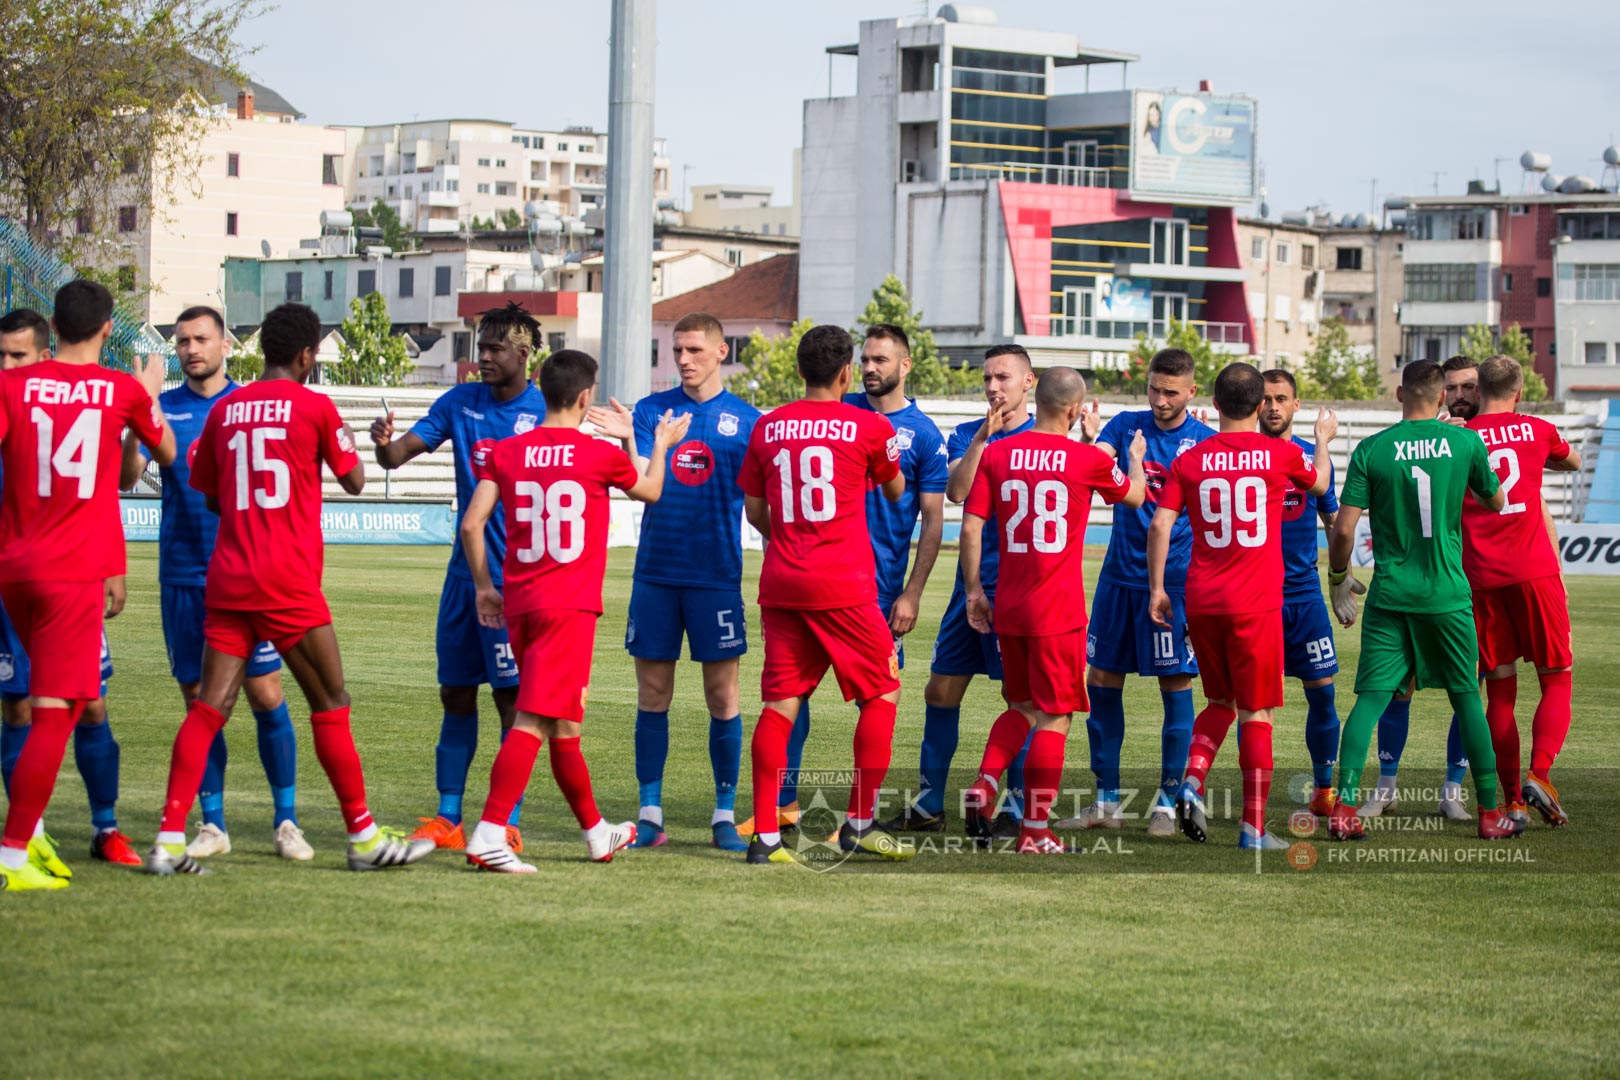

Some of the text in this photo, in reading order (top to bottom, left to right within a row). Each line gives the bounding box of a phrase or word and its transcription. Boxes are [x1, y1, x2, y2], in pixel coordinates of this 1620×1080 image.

[24, 378, 114, 407] FERATI
[222, 400, 292, 427] JAITEH
[765, 419, 857, 443] CARDOSO
[31, 406, 102, 499] 14
[525, 444, 575, 468] KOTE
[1010, 449, 1067, 472] DUKA
[1202, 450, 1270, 472] KALARI
[1394, 438, 1452, 461] XHIKA
[227, 427, 290, 511] 15
[1488, 448, 1526, 515] 2
[772, 445, 837, 523] 18
[1199, 476, 1267, 548] 99
[1411, 465, 1432, 538] 1
[363, 513, 421, 530] DURRES
[515, 480, 586, 563] 38
[1000, 479, 1068, 553] 28
[1558, 536, 1620, 563] OTO
[717, 609, 735, 640] 5
[1154, 632, 1174, 658] 10
[1306, 636, 1334, 662] 99
